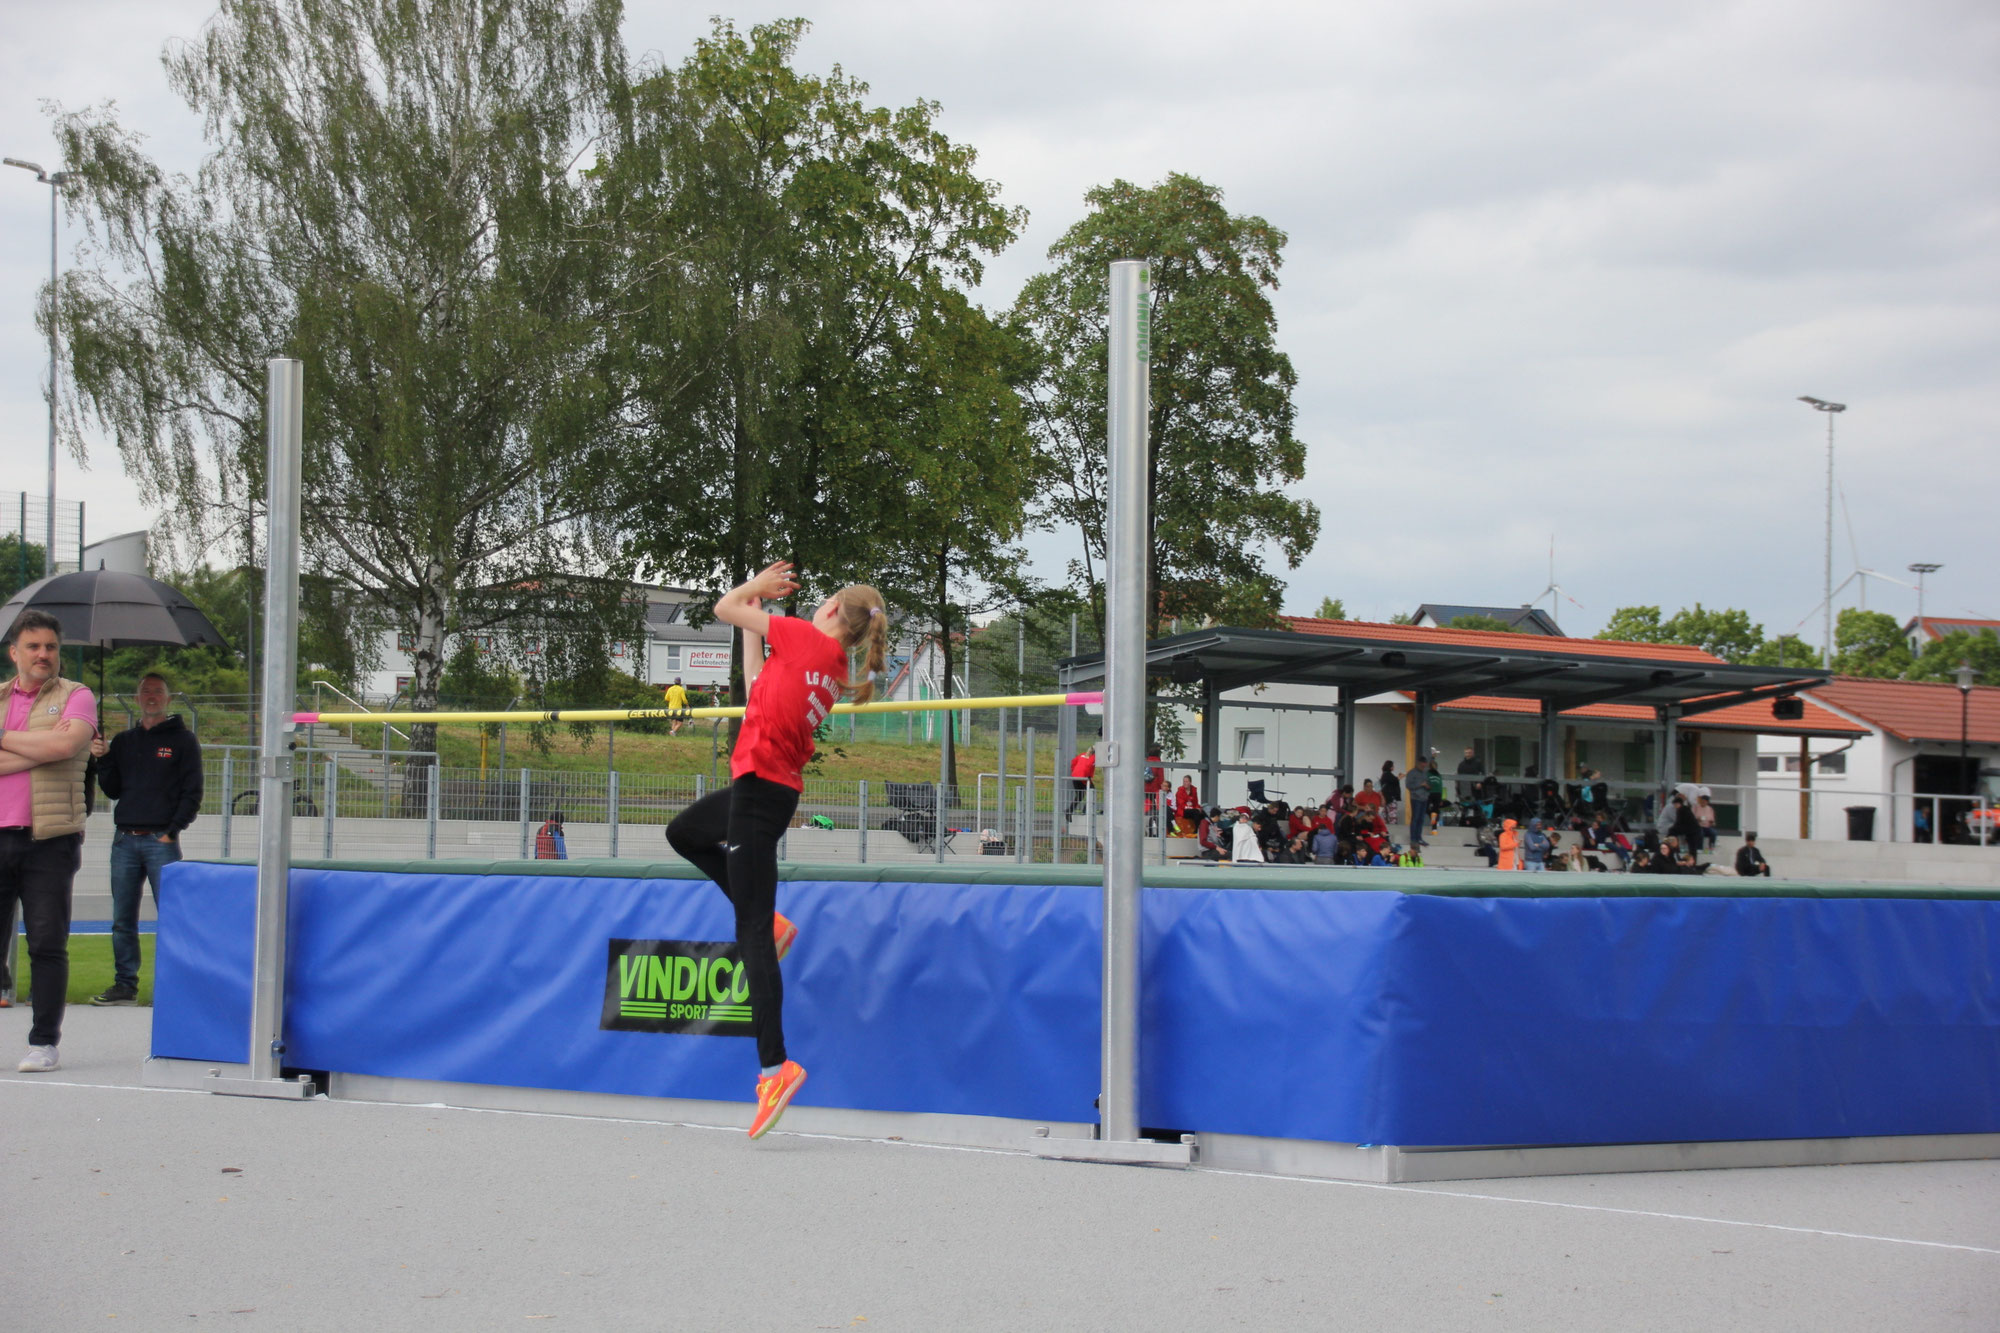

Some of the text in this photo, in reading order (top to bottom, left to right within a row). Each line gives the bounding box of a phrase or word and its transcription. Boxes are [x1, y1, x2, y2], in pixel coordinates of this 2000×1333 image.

[1137, 292, 1149, 362] VINDICO
[690, 651, 713, 659] peter
[805, 671, 820, 686] LG
[629, 709, 667, 718] GETRA
[619, 954, 750, 1004] VINDICO
[669, 1003, 709, 1020] SPORT
